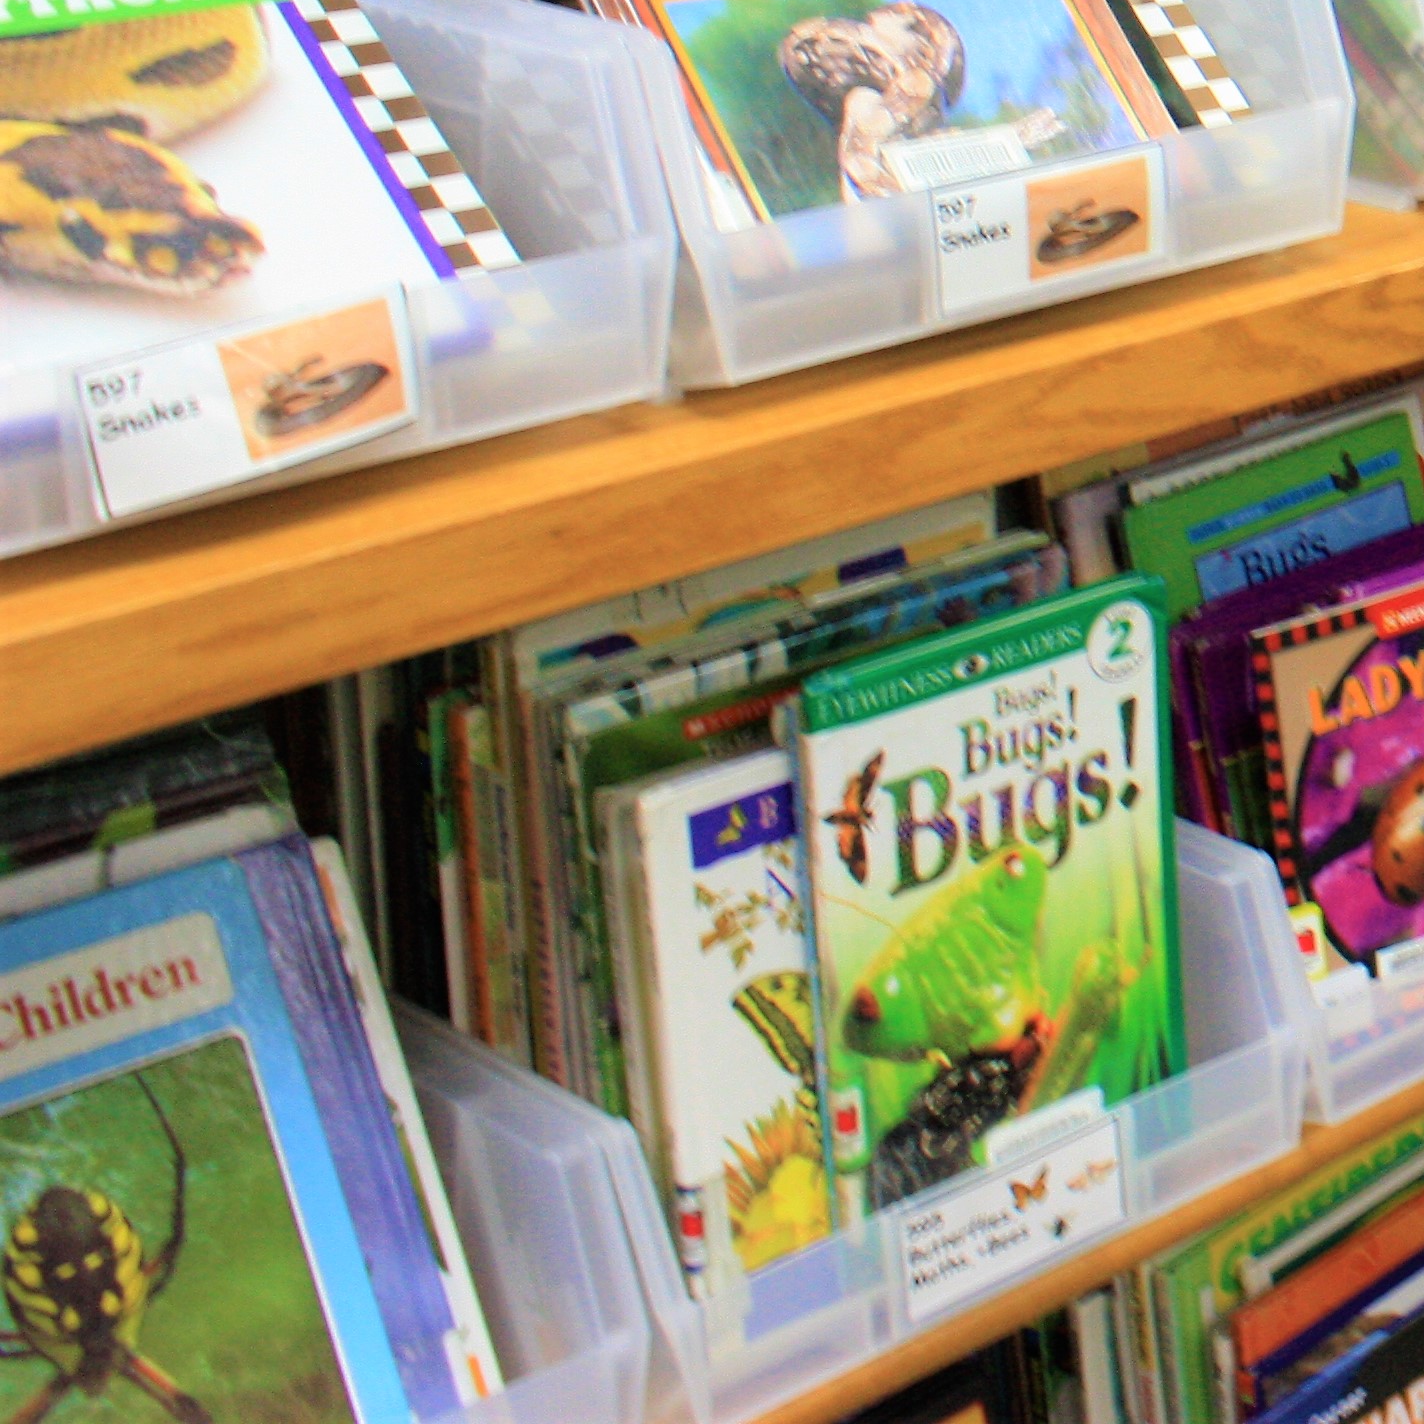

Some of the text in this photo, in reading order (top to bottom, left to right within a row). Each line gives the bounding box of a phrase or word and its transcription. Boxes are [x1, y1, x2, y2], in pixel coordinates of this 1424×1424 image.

[99, 395, 201, 442] Snakes
[1105, 620, 1133, 663] 2
[958, 684, 1079, 775] Bugs!
[880, 696, 1140, 898] Bugs!
[0, 953, 202, 1052] Children
